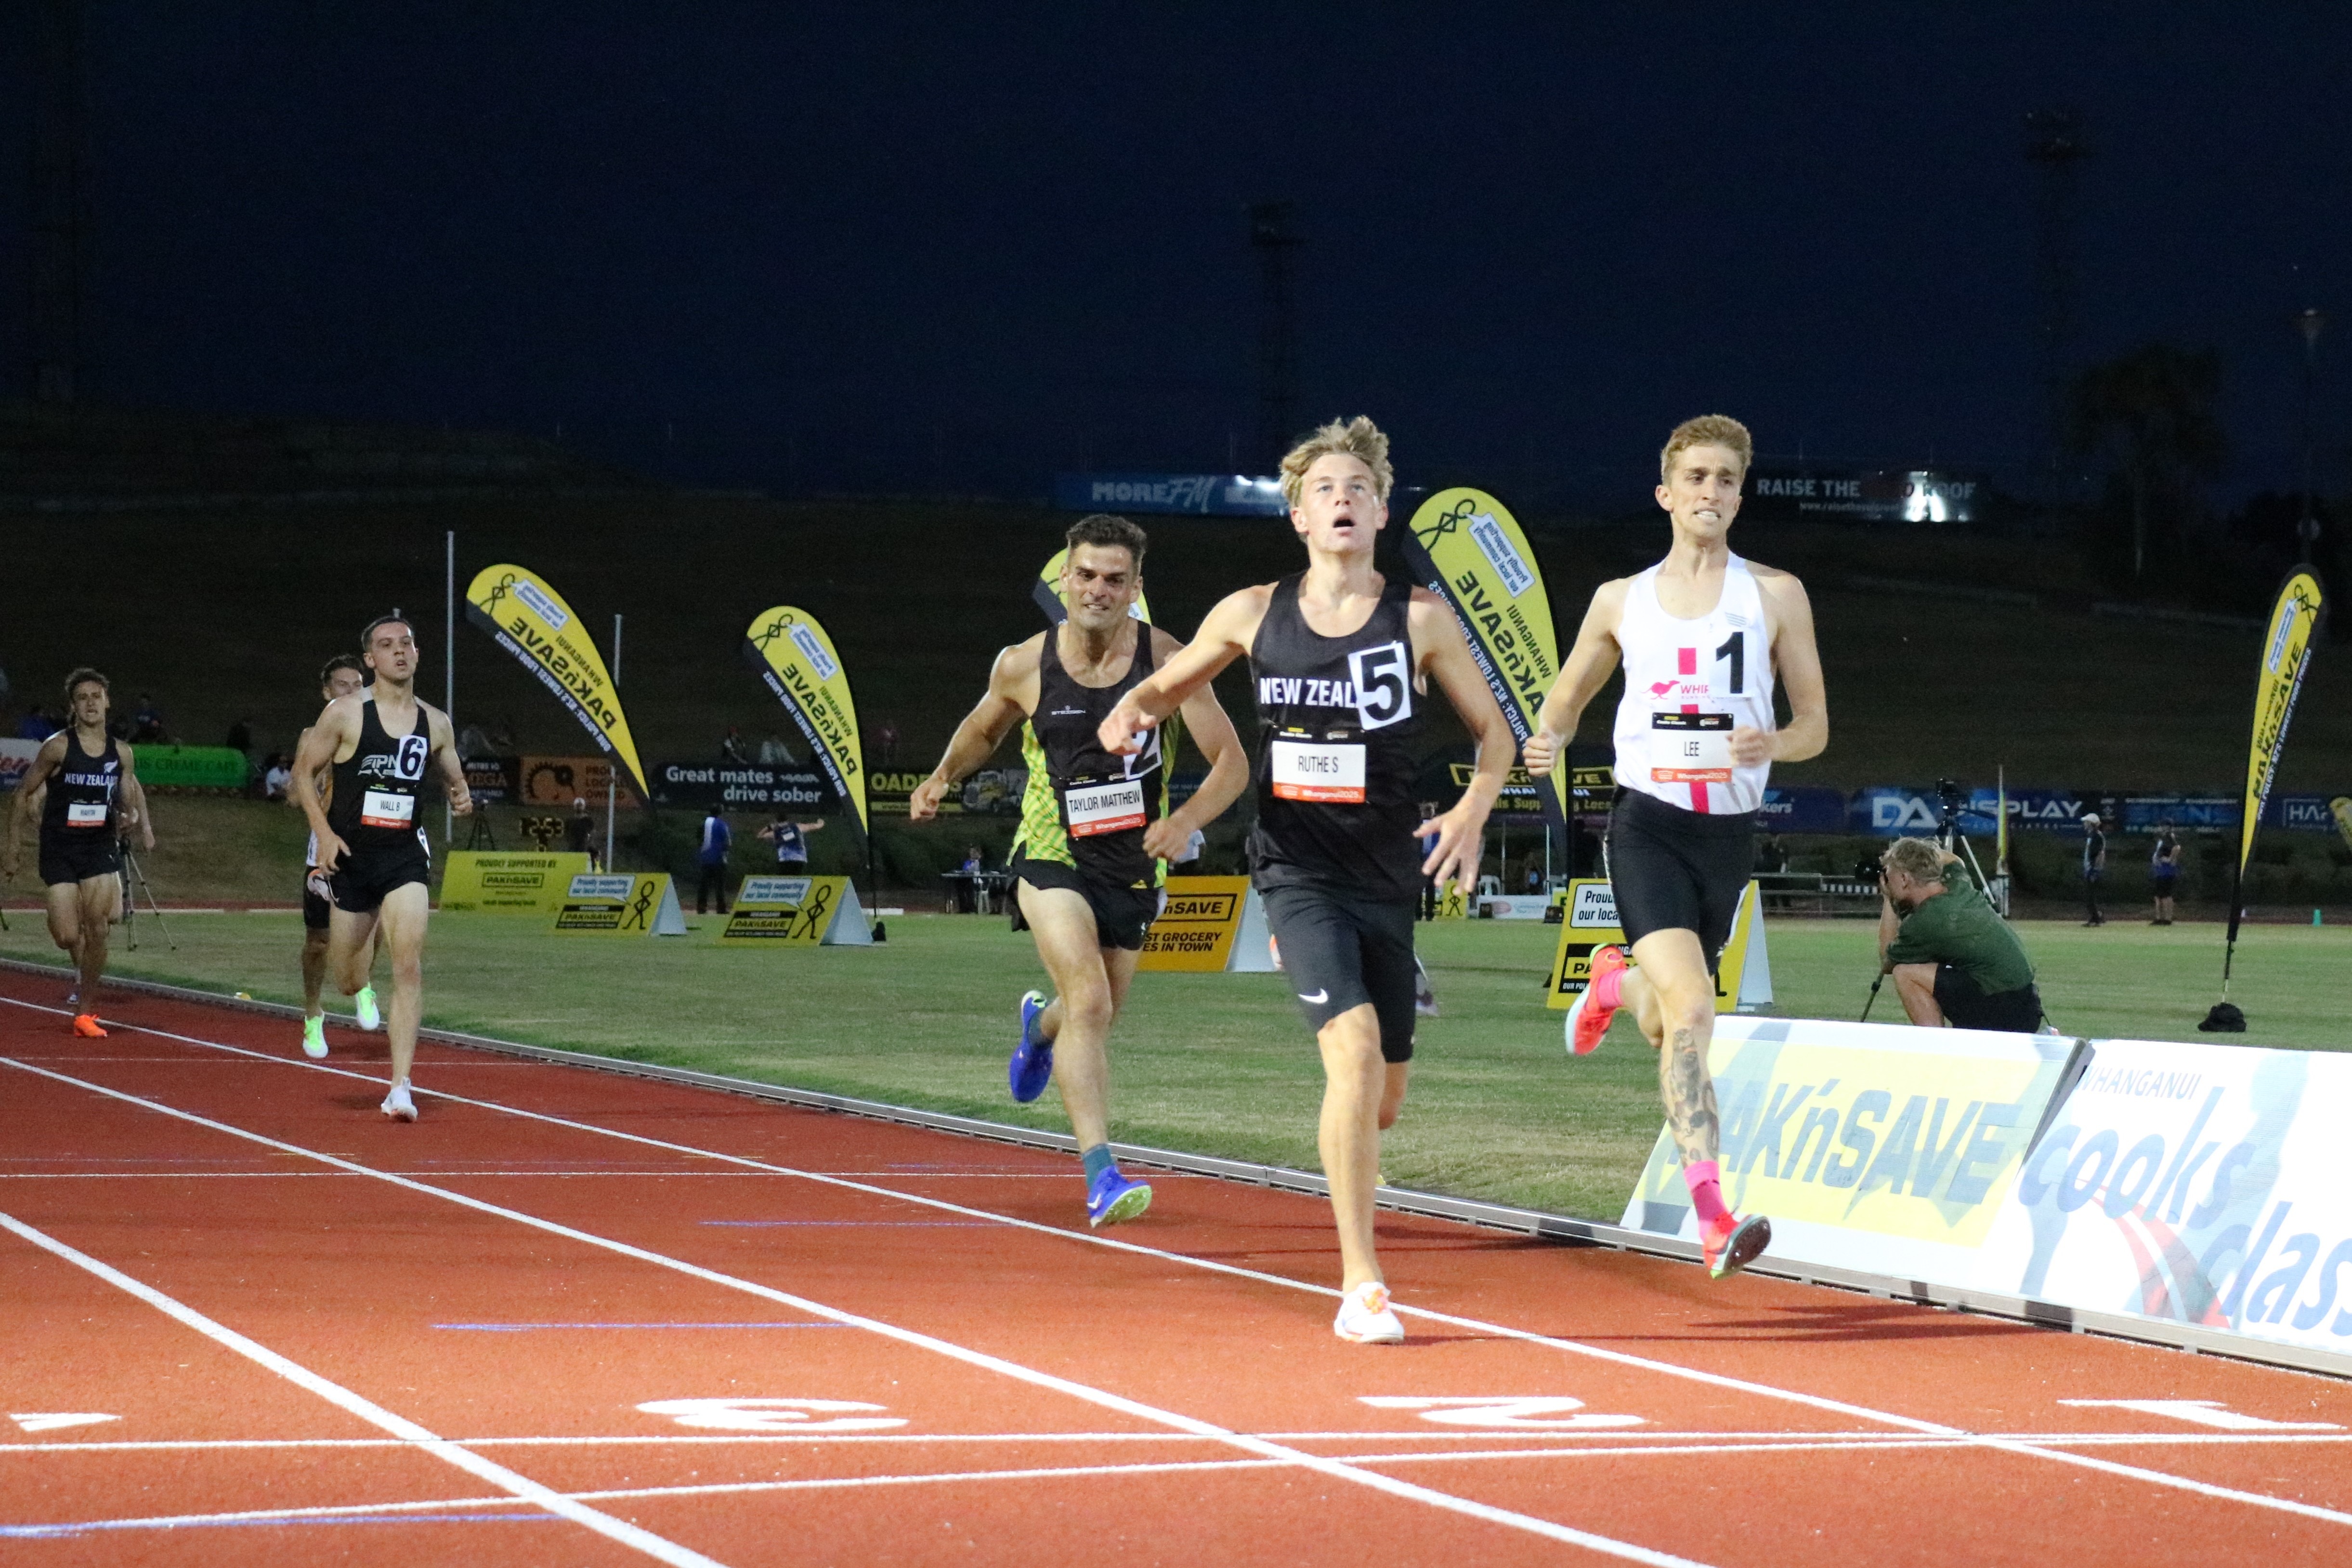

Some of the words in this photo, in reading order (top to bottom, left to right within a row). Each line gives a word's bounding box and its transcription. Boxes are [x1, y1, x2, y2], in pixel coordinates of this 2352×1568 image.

[1757, 478, 1816, 497] RAISE
[1823, 480, 1862, 497] THE
[1716, 631, 1744, 694] 1
[1260, 678, 1302, 705] NEW
[1305, 679, 1358, 708] ZEAL
[1360, 648, 1404, 721] 5
[400, 738, 423, 777] 6
[1130, 725, 1157, 776] 2
[1684, 742, 1699, 756] LEE
[1298, 756, 1329, 772] RUTHE
[1332, 757, 1338, 772] S
[65, 772, 86, 785] NEW
[666, 766, 716, 783] Great
[720, 769, 773, 784] mates
[724, 784, 768, 802] drive
[773, 786, 822, 803] sober
[1069, 797, 1099, 813] TAYLOR
[1101, 790, 1141, 808] MATTHEW
[380, 800, 394, 811] WALL
[396, 802, 400, 811] B
[1872, 797, 1940, 828] DA
[1585, 890, 1613, 903] Prou
[1578, 910, 1595, 920] our
[1598, 908, 1619, 920] loca
[1162, 932, 1222, 942] GROCERY
[1161, 942, 1175, 952] IN
[1178, 942, 1214, 952] TOWN
[2077, 1065, 2202, 1100] WHANGANUI
[2018, 1086, 2256, 1230] cooks
